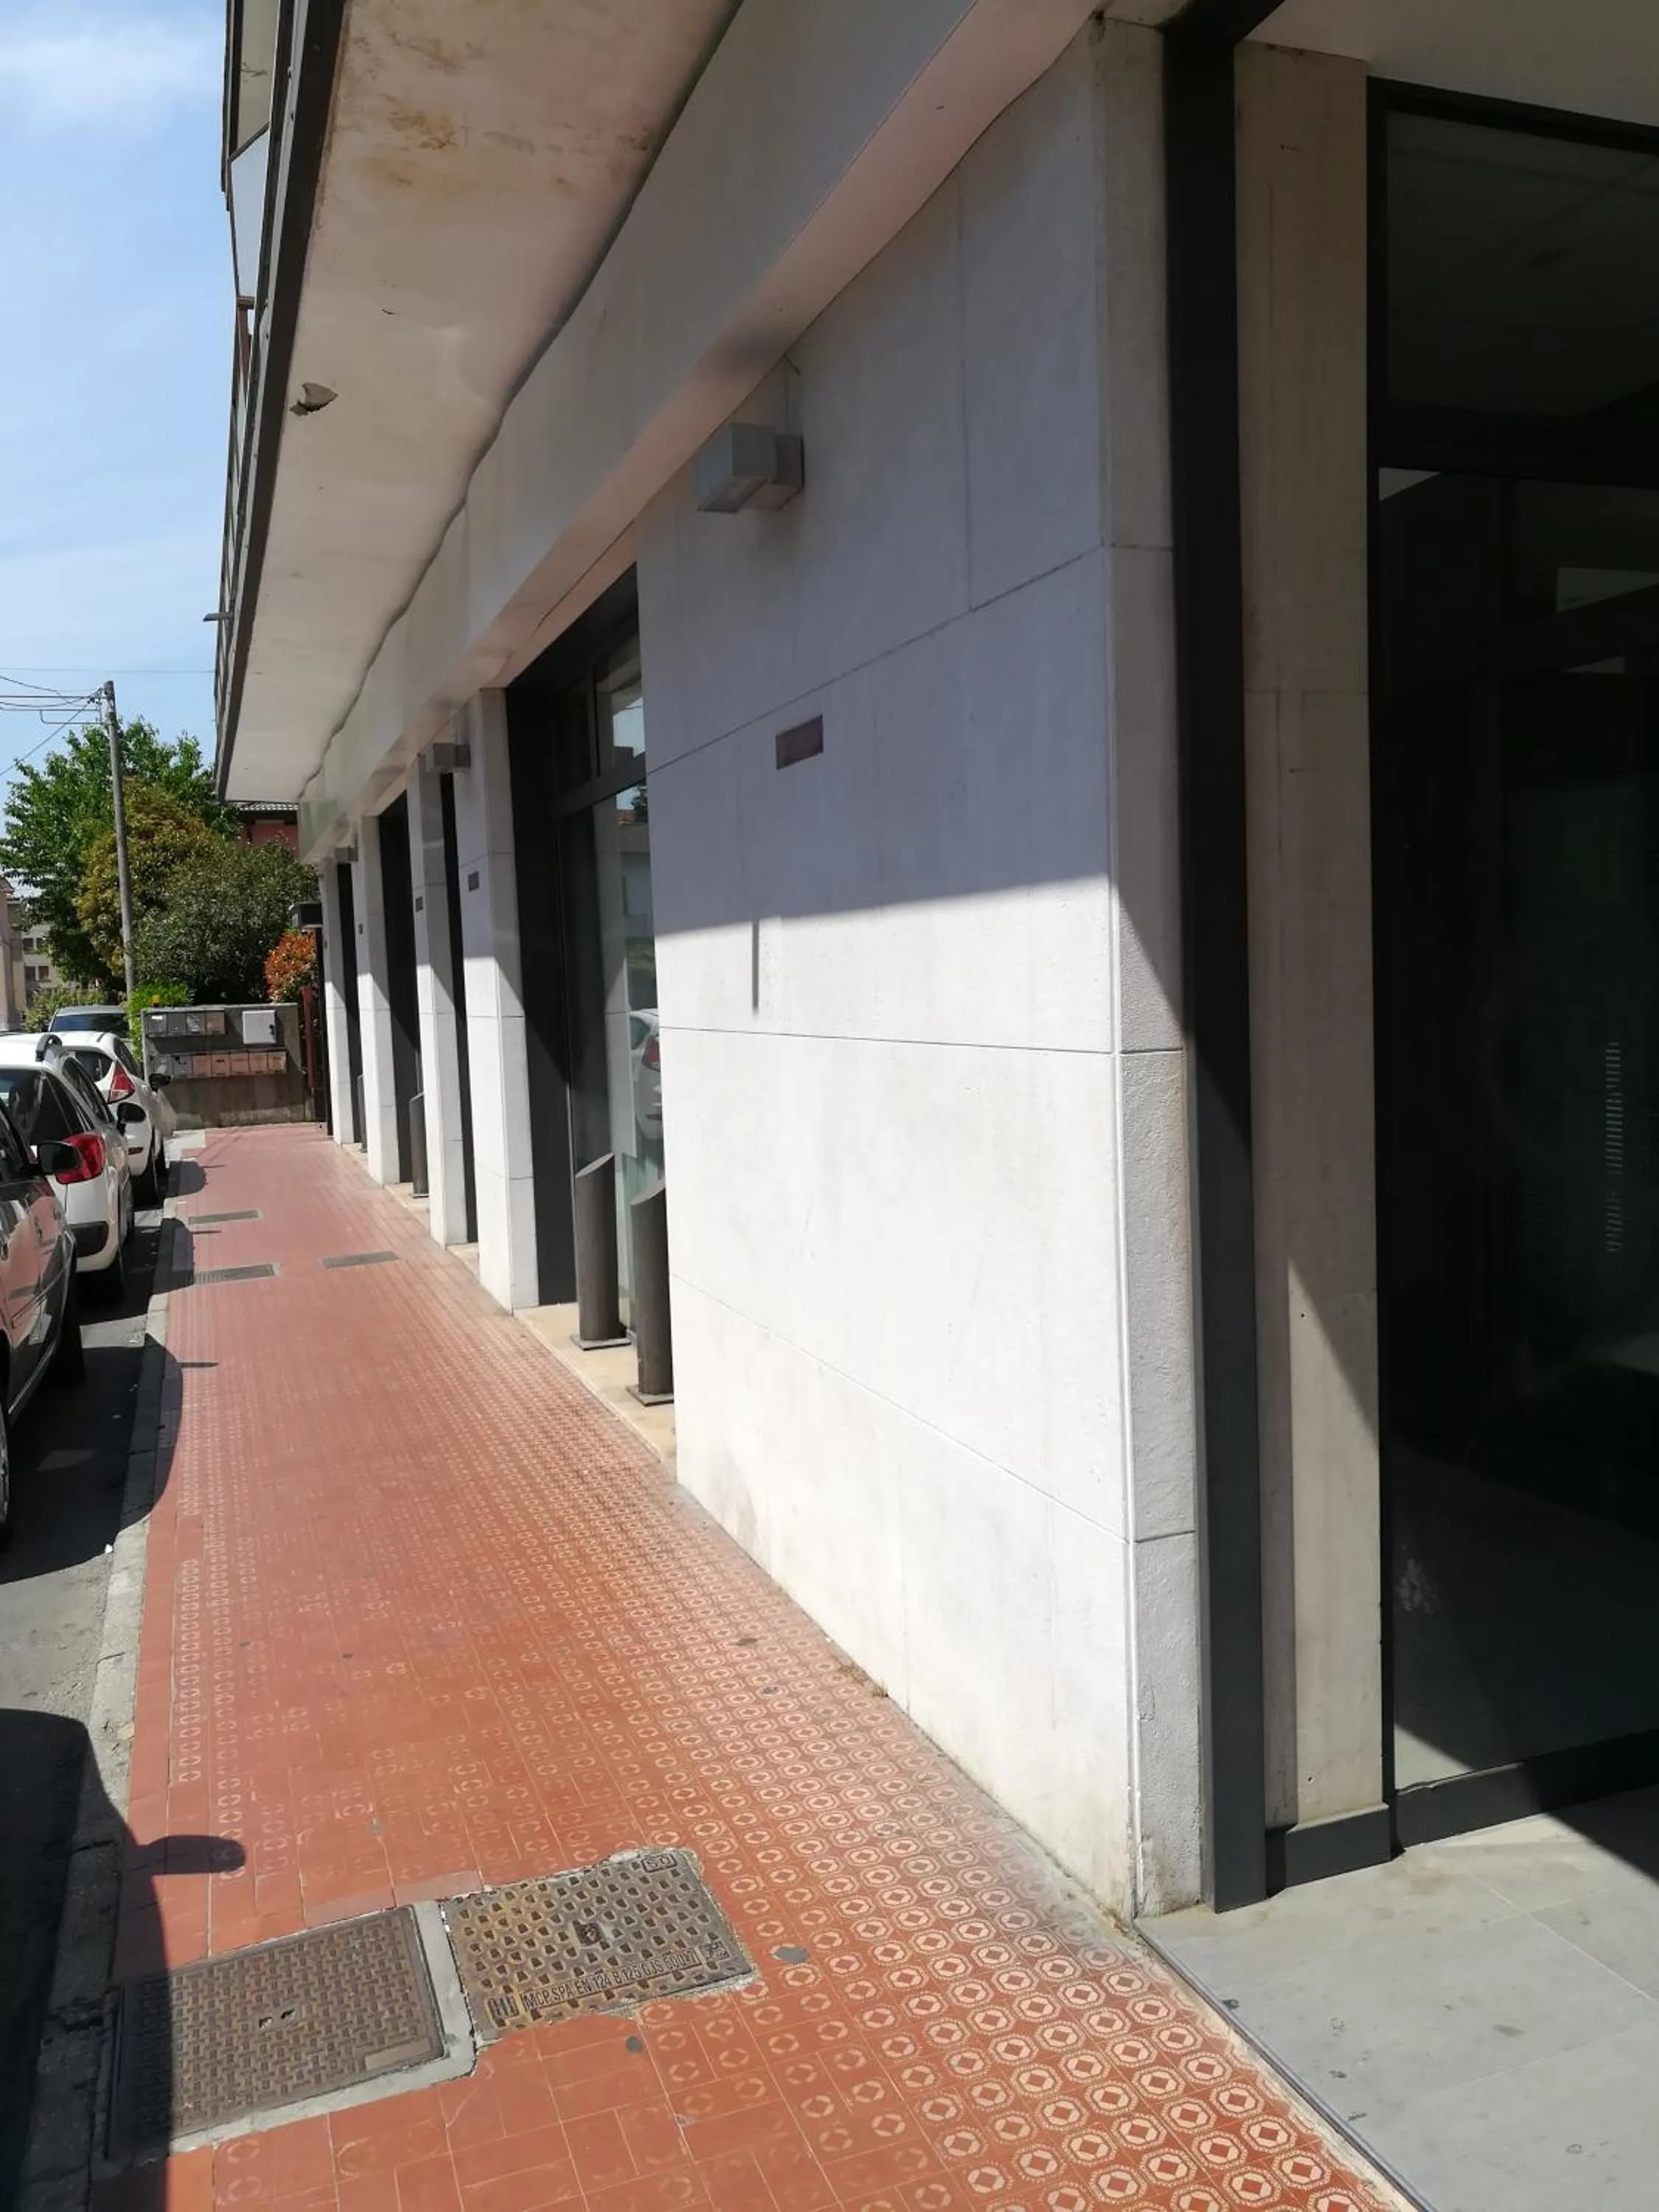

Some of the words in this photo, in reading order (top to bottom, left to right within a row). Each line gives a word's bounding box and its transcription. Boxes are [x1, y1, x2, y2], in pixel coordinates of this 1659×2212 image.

[551, 1983, 574, 2001] SPA
[574, 1978, 592, 1994] EN
[593, 1972, 613, 1989] 124
[612, 1970, 622, 1984] B
[622, 1964, 642, 1981] 125
